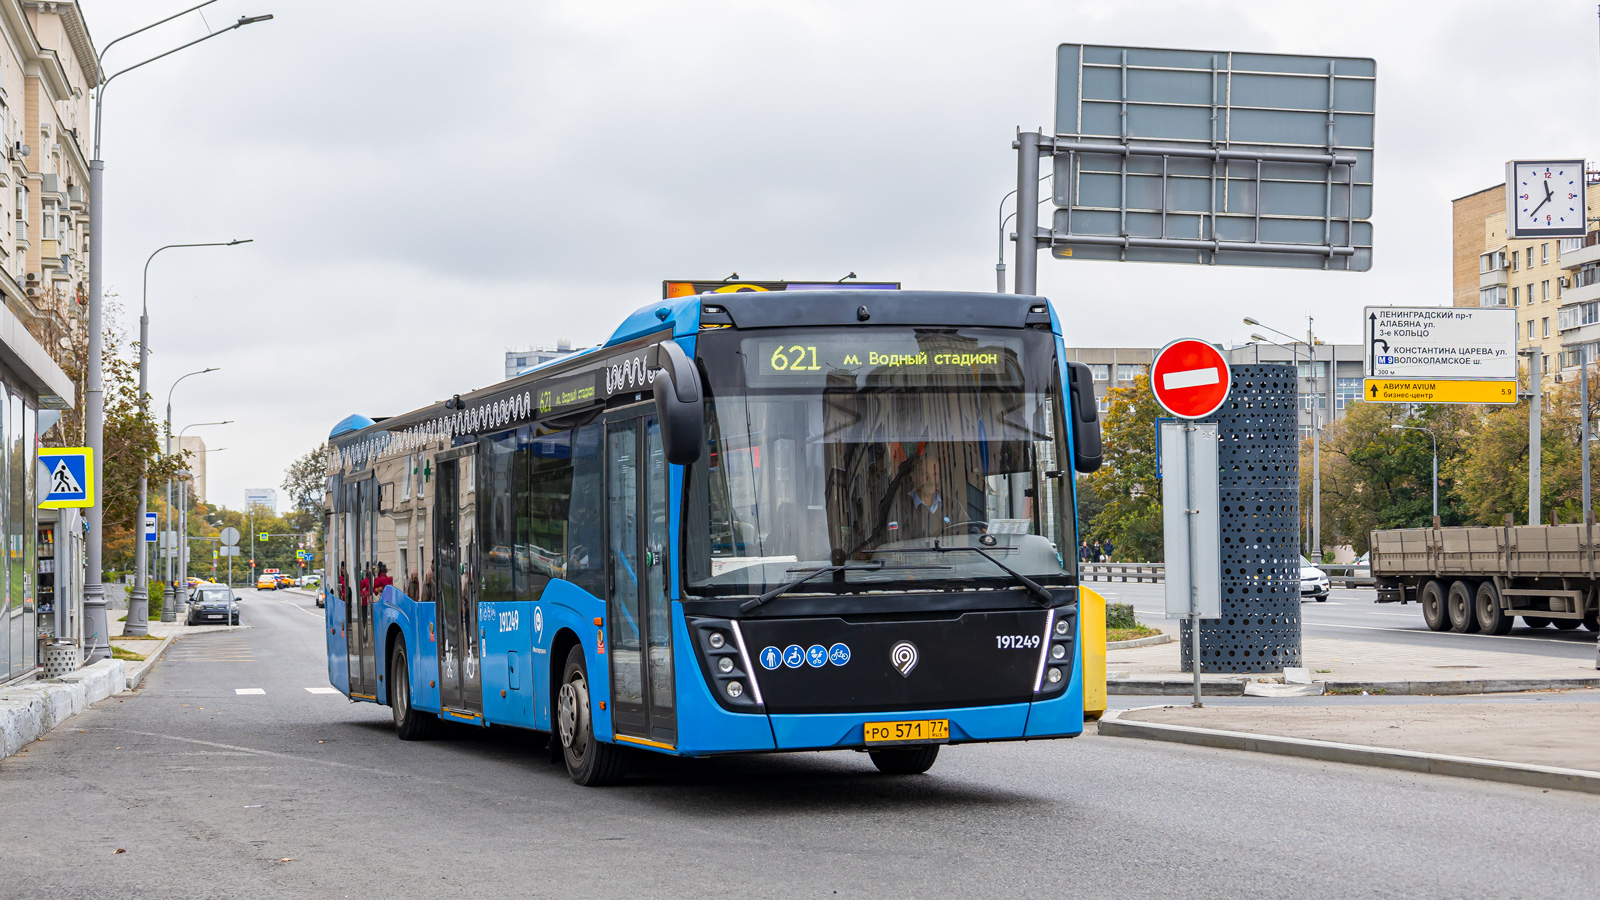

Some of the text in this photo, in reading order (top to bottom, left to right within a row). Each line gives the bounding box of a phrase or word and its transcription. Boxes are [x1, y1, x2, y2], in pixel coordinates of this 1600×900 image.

[1380, 311, 1453, 319] ЛЕНИНГРАДСКИЙ
[1394, 329, 1429, 338] КОЛЬЦО
[771, 345, 997, 371] 621 м. Водный стадион
[1394, 347, 1507, 357] КОНСТАНТИНА ЦАРЕВА ул.
[1394, 356, 1470, 365] ВОЛОКОЛАМСКОЕ
[1384, 391, 1433, 399] бизнес-центр
[540, 391, 551, 413] 621
[499, 609, 519, 632] 191249
[996, 635, 1040, 649] 191249
[896, 723, 921, 738] 571
[930, 721, 943, 732] 77
